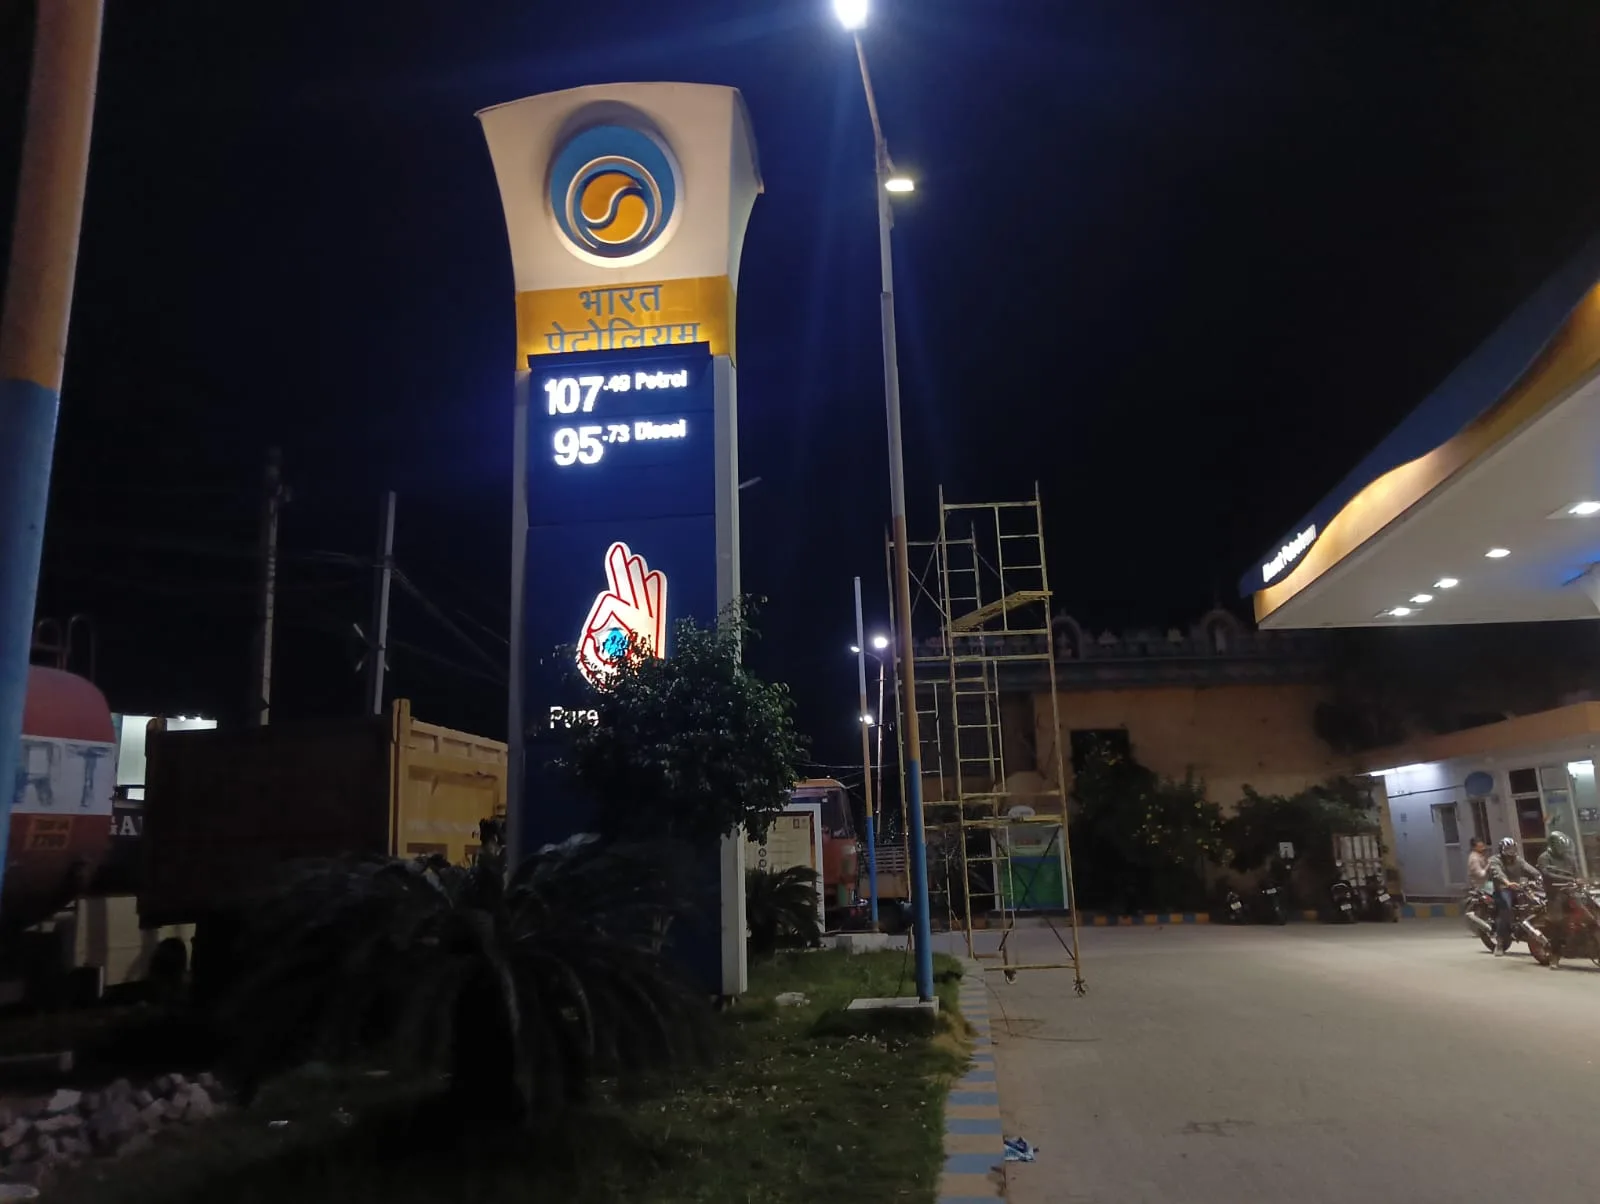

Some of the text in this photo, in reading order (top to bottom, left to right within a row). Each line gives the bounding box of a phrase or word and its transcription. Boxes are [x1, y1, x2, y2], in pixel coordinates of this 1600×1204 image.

[580, 285, 663, 316] भारत
[634, 369, 688, 390] Petrol
[634, 418, 687, 441] Diesel
